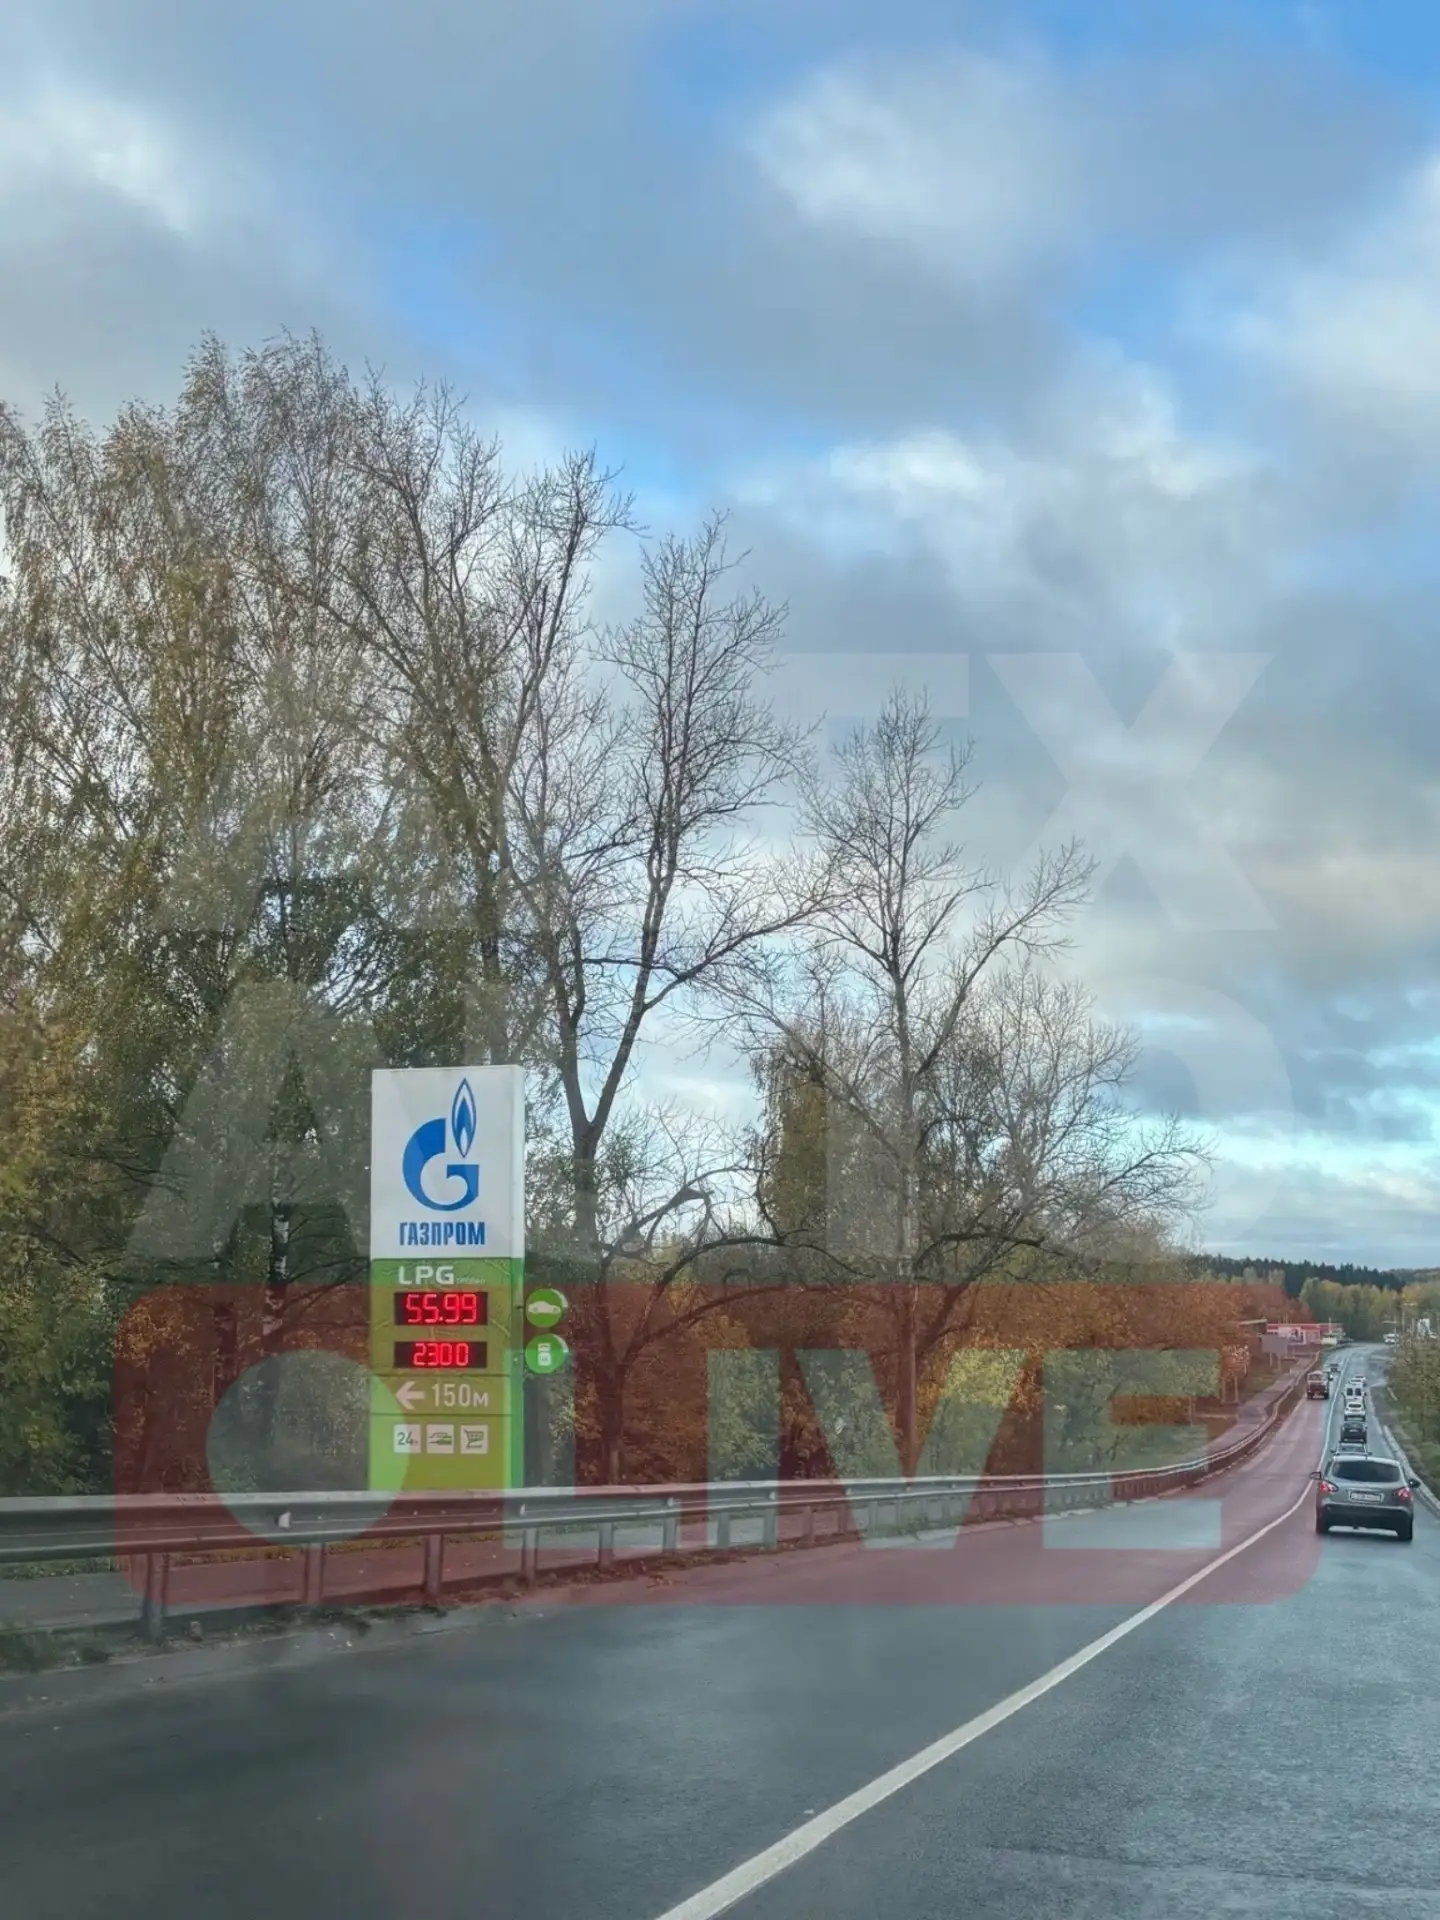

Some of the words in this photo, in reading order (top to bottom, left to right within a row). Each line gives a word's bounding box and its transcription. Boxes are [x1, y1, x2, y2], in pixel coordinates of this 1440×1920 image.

[399, 1221, 486, 1246] ГАЗПРОМ
[398, 1265, 455, 1285] LPG
[406, 1293, 477, 1323] 55.99
